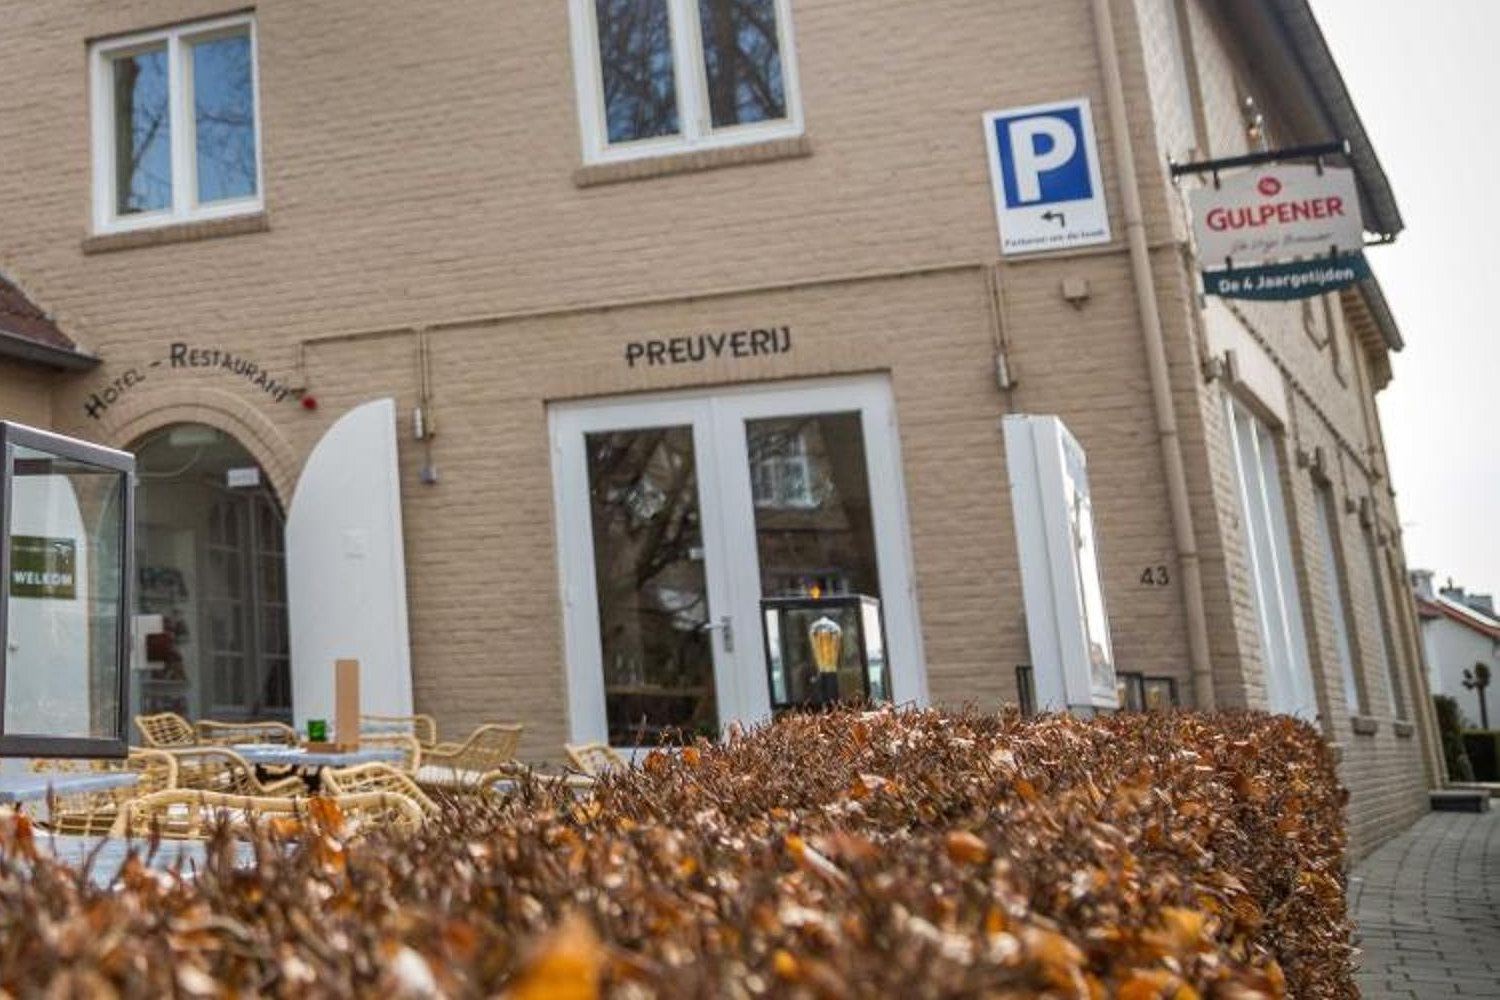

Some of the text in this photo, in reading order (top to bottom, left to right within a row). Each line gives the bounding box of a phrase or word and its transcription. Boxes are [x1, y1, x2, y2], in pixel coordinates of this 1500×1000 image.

[1007, 115, 1078, 203] P
[1206, 196, 1343, 231] GULPENER
[1218, 279, 1239, 293] De
[1256, 268, 1355, 290] Jaargetijden
[626, 326, 792, 367] PREUVERIJ
[13, 571, 73, 585] WELKOM
[1140, 566, 1169, 586] 43
